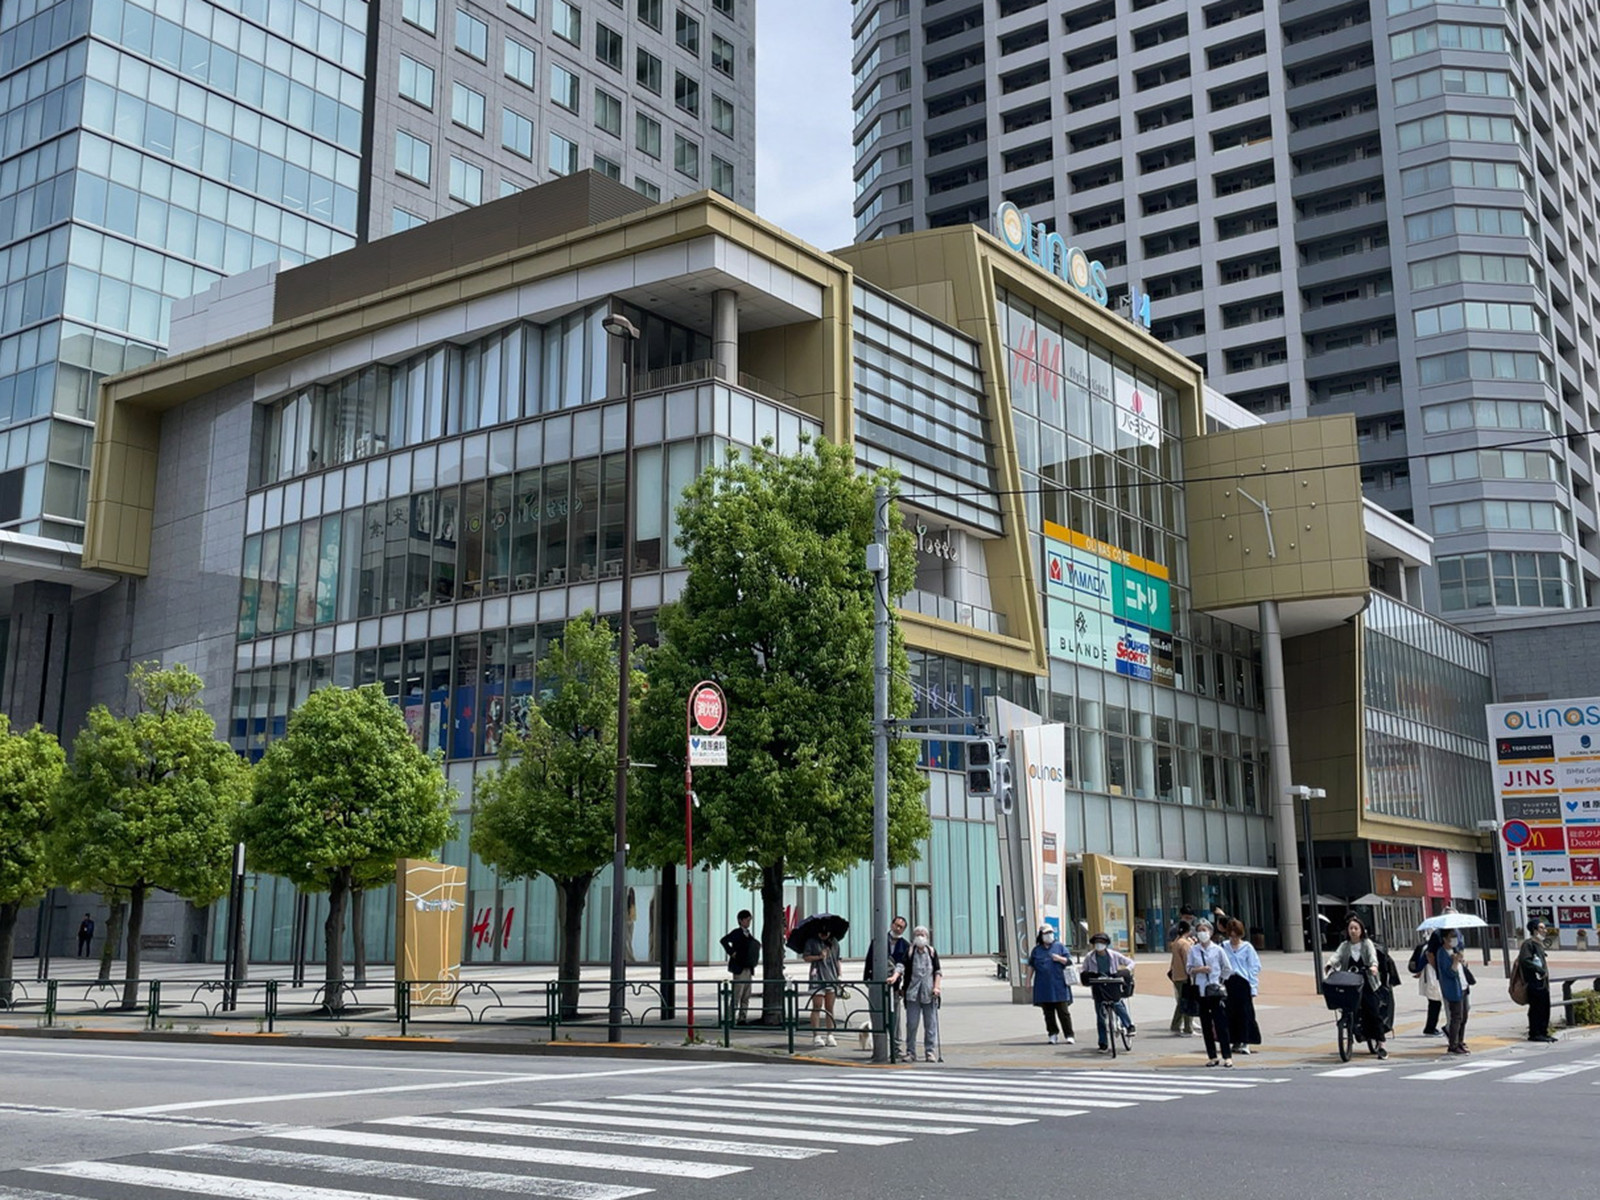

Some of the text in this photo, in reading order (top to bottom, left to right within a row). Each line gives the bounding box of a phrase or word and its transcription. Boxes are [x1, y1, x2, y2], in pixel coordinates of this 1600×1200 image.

[1013, 325, 1061, 402] H&M
[1122, 413, 1156, 441] バーミヤン
[1066, 561, 1107, 595] YAMADA
[1126, 579, 1158, 615] ニトリ
[1060, 637, 1108, 662] BLANDE
[1116, 641, 1148, 665] SPORTS
[1124, 633, 1150, 655] SUPER
[471, 907, 515, 950] H&M
[1573, 911, 1590, 919] KFC
